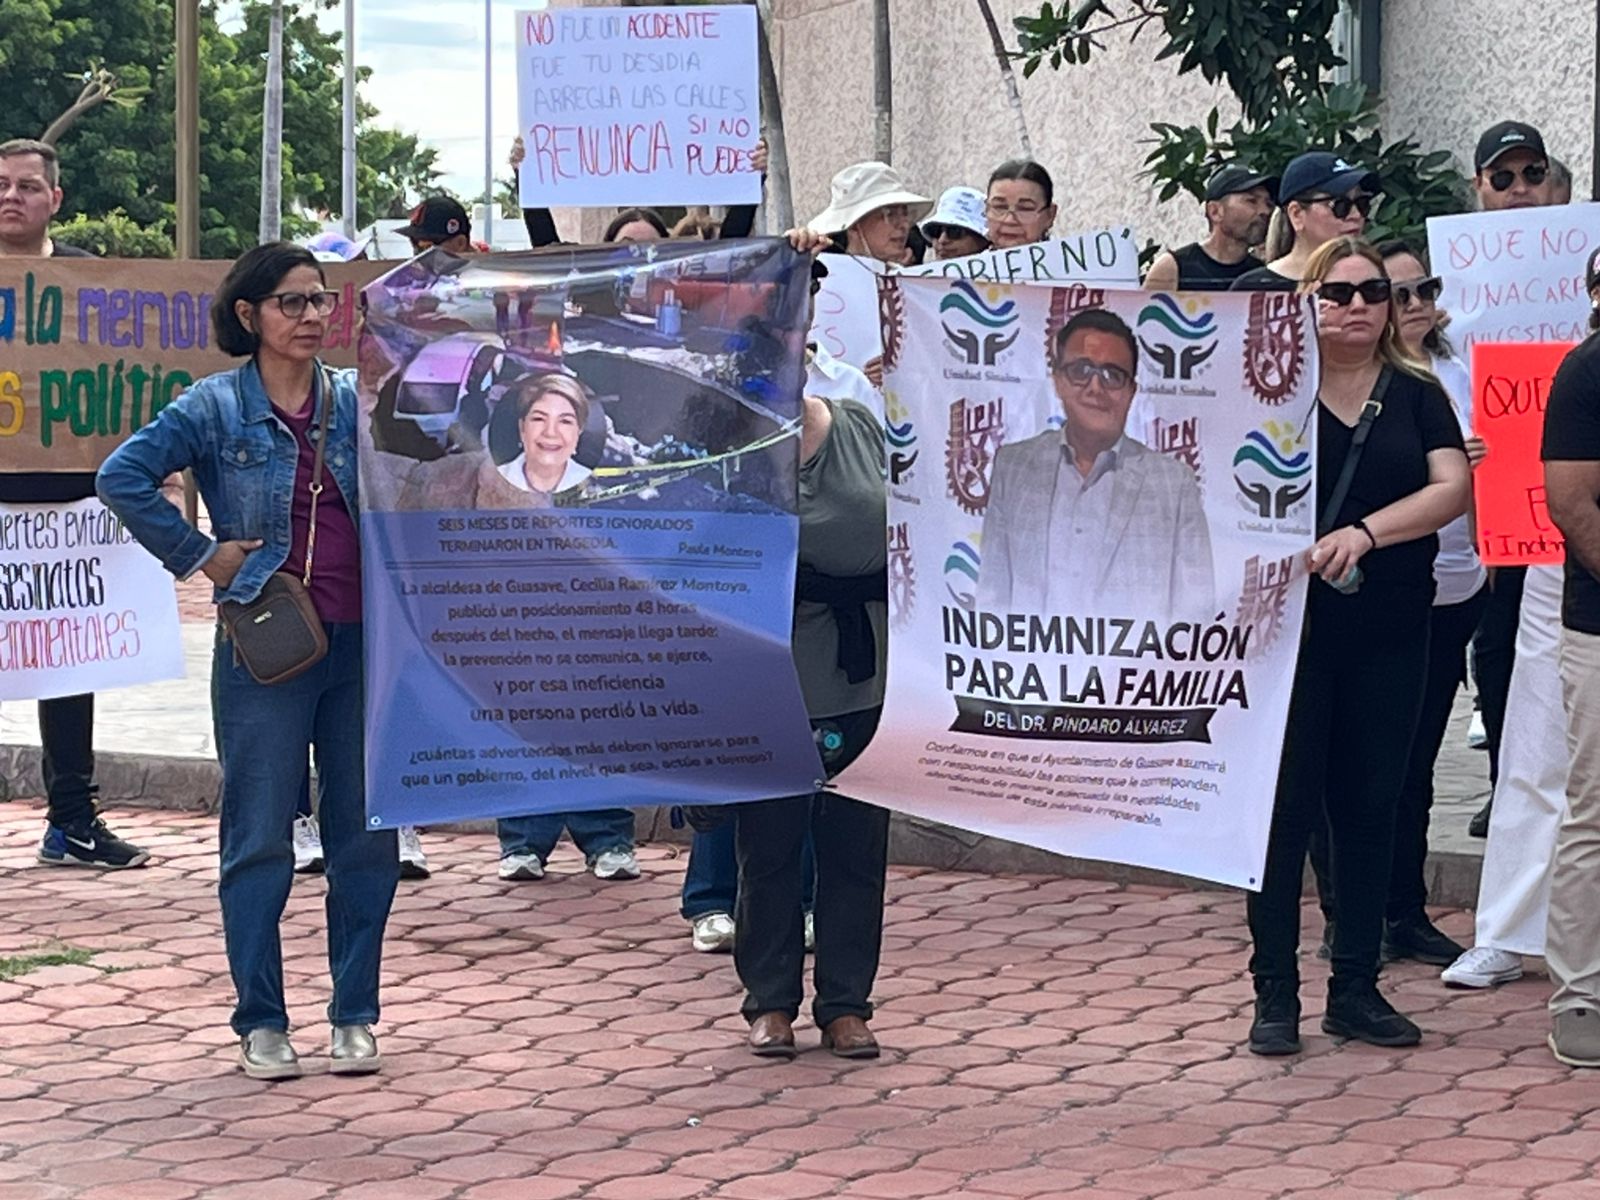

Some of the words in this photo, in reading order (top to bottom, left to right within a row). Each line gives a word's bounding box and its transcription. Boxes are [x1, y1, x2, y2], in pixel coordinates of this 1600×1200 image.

[526, 14, 554, 46] NO
[560, 16, 596, 43] FUE
[600, 16, 621, 39] UN
[627, 12, 720, 39] ACCIDENTE
[531, 56, 565, 79] FUE
[585, 54, 611, 73] TU
[623, 52, 701, 73] DESIDIA
[534, 85, 622, 116] ARREGLA
[632, 85, 665, 109] LAS
[674, 84, 747, 112] CALLES
[530, 120, 673, 186] RENUNCIA
[688, 114, 707, 135] SI
[718, 118, 750, 138] NO
[687, 144, 756, 175] PUEDES
[1448, 230, 1525, 271] QUE
[1541, 227, 1588, 260] NO
[25, 271, 63, 345] la
[438, 517, 465, 532] SEIS
[468, 516, 509, 531] MESES
[511, 516, 529, 530] DE
[532, 515, 603, 529] REPORTES
[607, 516, 694, 531] IGNORADOS
[440, 538, 523, 553] TERMINARON
[526, 537, 543, 550] EN
[401, 580, 418, 596] La
[421, 580, 483, 595] alcaldesa
[485, 580, 503, 594] de
[505, 579, 568, 595] Guasave,
[570, 577, 615, 592] Cecilia
[682, 577, 751, 595] Montoya,
[448, 604, 497, 621] publicó
[501, 606, 518, 618] un
[521, 602, 632, 620] posicionamiento
[657, 599, 697, 615] horas
[431, 627, 486, 645] después
[489, 626, 511, 642] del
[562, 626, 575, 641] el
[579, 625, 635, 642] mensaje
[638, 625, 674, 642] llega
[942, 606, 1253, 662] INDEMNIZACIÓN
[444, 652, 457, 666] la
[460, 651, 532, 668] prevención
[535, 654, 553, 666] no
[557, 653, 572, 665] se
[647, 651, 663, 662] se
[493, 680, 503, 695] y
[508, 678, 536, 695] por
[540, 678, 568, 692] esa
[573, 673, 665, 691] ineficiencia
[944, 652, 1048, 702] PARA
[1059, 664, 1105, 705] LA
[1115, 667, 1250, 709] FAMILIA
[470, 708, 504, 722] una
[509, 706, 575, 723] persona
[581, 700, 635, 722] perdió
[640, 702, 657, 717] la
[983, 709, 1017, 730] DEL
[1020, 713, 1047, 732] DR.
[1052, 713, 1121, 735] PÍNDARO
[1124, 715, 1188, 736] ÁLVAREZ
[409, 745, 476, 765] ¿cuántas
[480, 742, 572, 760] advertencias
[575, 740, 604, 755] más
[607, 739, 651, 754] deben
[655, 738, 722, 752] ignorarse
[726, 735, 759, 749] para
[925, 741, 988, 758] Confiamos
[990, 750, 1005, 761] en
[1008, 752, 1029, 763] que
[1031, 753, 1041, 763] el
[1119, 757, 1133, 769] de
[401, 773, 429, 788] que
[434, 772, 453, 785] un
[457, 768, 527, 787] gobierno,
[531, 766, 555, 782] del
[559, 763, 595, 779] nivel
[600, 764, 626, 779] que
[705, 757, 713, 767] a
[943, 759, 1036, 779] responsabilidad
[1055, 773, 1103, 785] acciones
[1106, 777, 1127, 788] que
